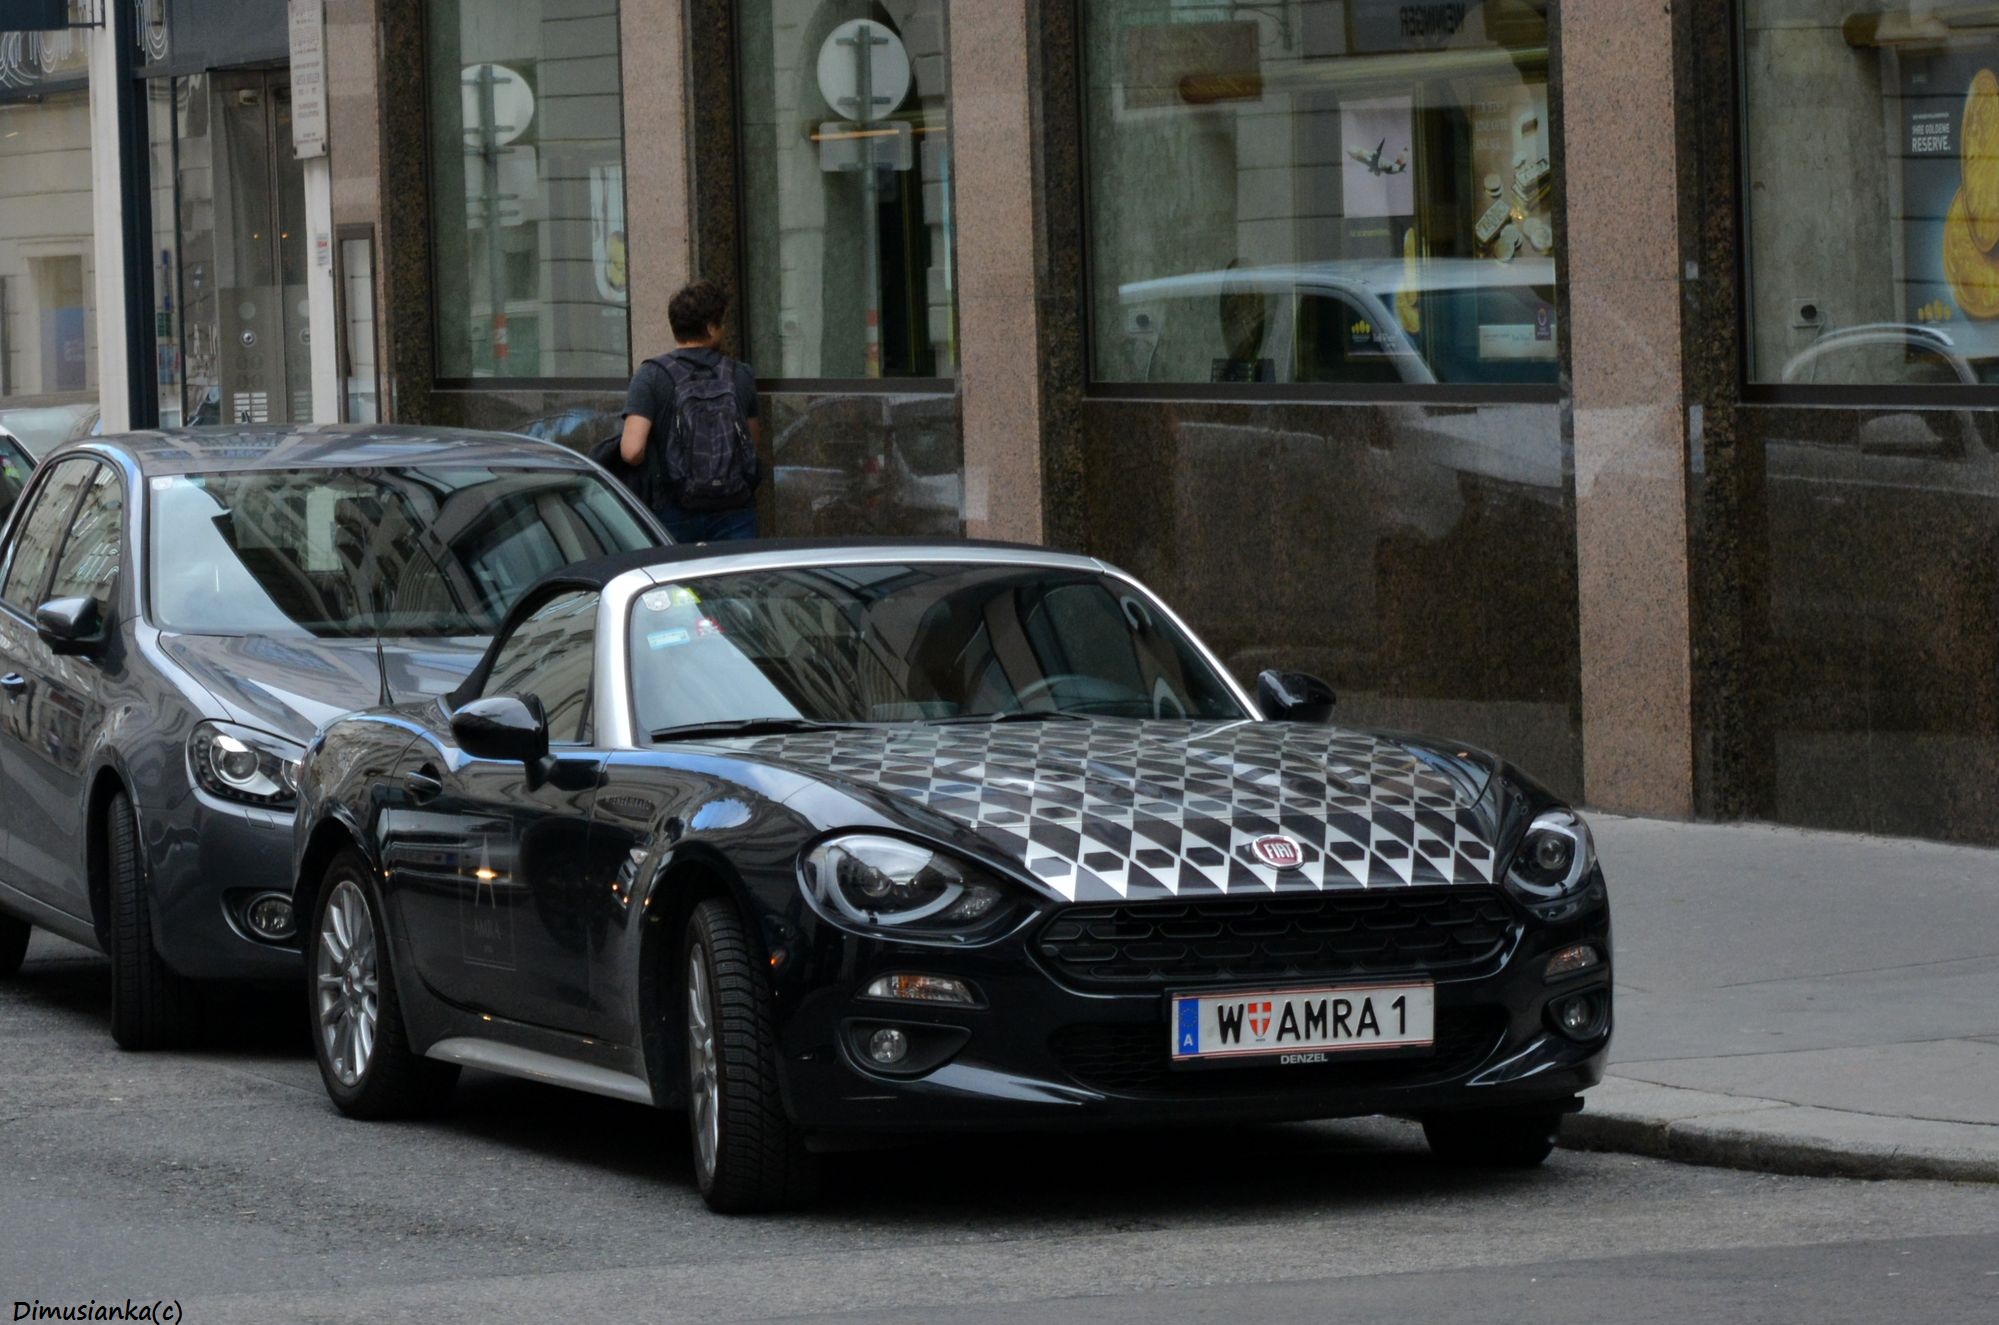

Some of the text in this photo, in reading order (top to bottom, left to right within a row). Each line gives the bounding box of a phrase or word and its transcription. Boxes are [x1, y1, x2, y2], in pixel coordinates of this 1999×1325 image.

[1911, 135, 1951, 152] RESERVE.
[1265, 843, 1293, 859] FIAT
[1217, 995, 1406, 1044] W AMRA 1
[1183, 1033, 1193, 1047] A
[1280, 1052, 1328, 1065] DENZEL
